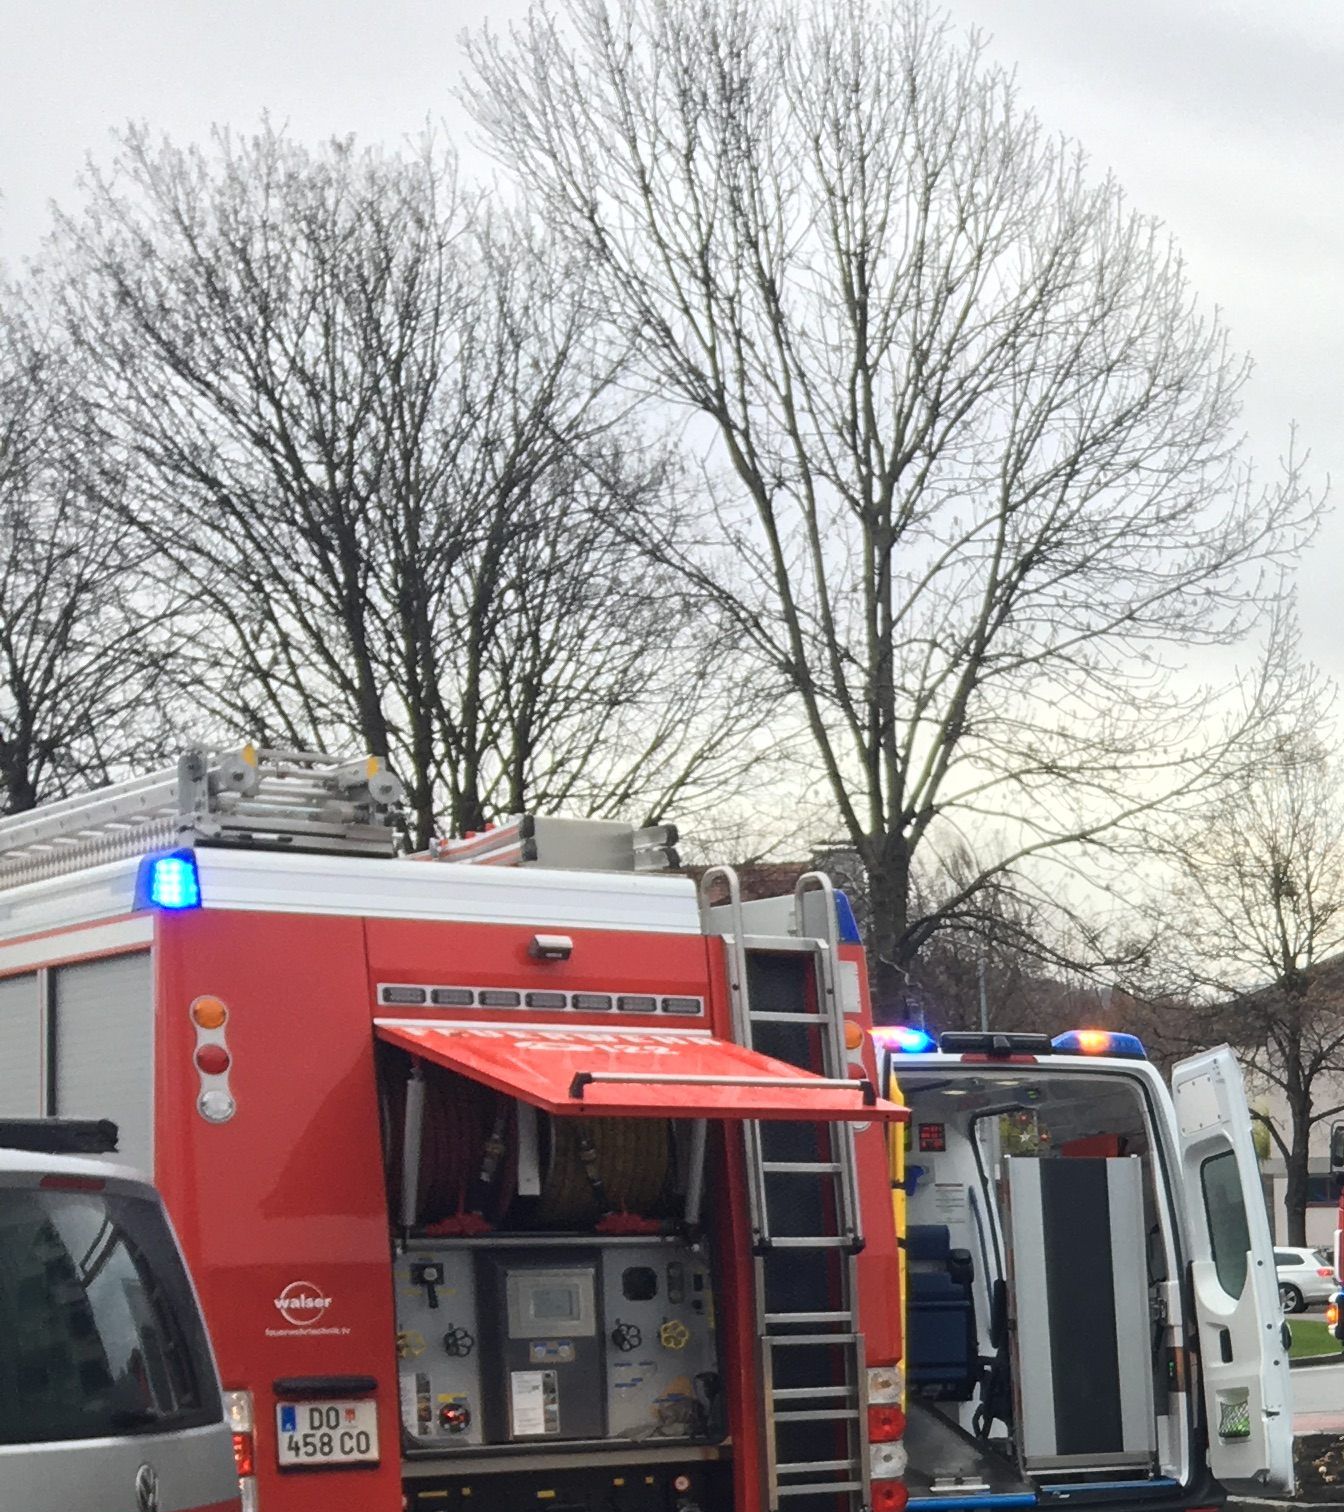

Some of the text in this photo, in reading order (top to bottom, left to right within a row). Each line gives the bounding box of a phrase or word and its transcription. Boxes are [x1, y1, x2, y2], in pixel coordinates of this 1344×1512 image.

[273, 1293, 332, 1309] walser
[309, 1406, 340, 1430] DO
[287, 1431, 370, 1457] 458 CO
